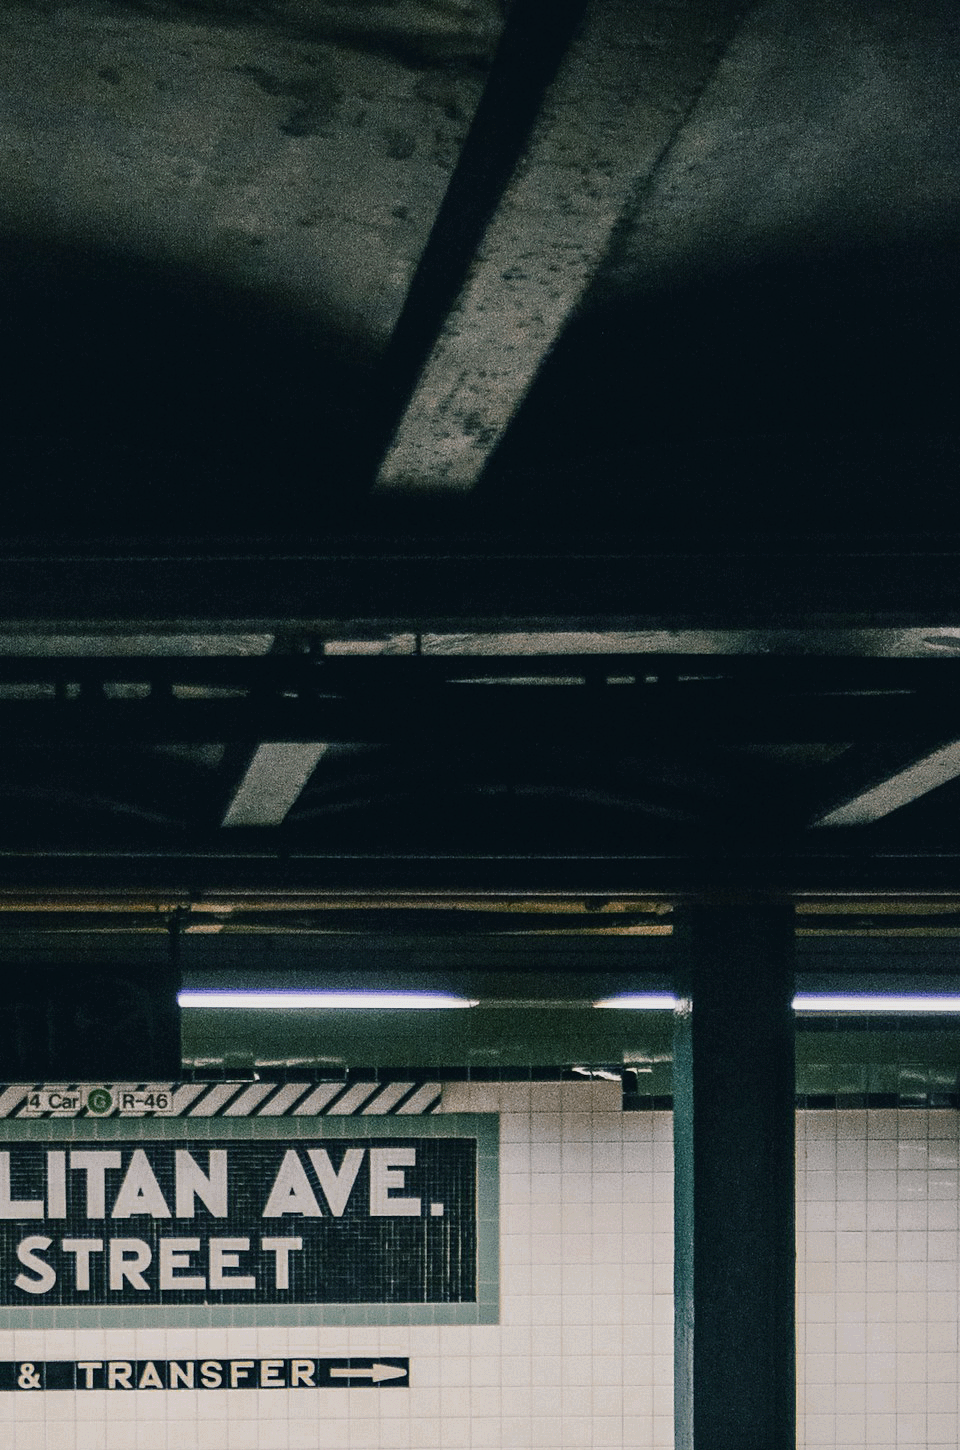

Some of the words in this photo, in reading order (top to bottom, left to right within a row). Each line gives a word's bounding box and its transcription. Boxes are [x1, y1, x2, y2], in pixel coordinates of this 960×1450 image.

[26, 1094, 40, 1108] 4
[48, 1093, 79, 1109] Car
[123, 1093, 168, 1109] R-46
[262, 1147, 444, 1218] AVE.
[14, 1235, 302, 1294] STREET
[17, 1363, 41, 1389] &
[78, 1361, 315, 1388] TRANSFER
